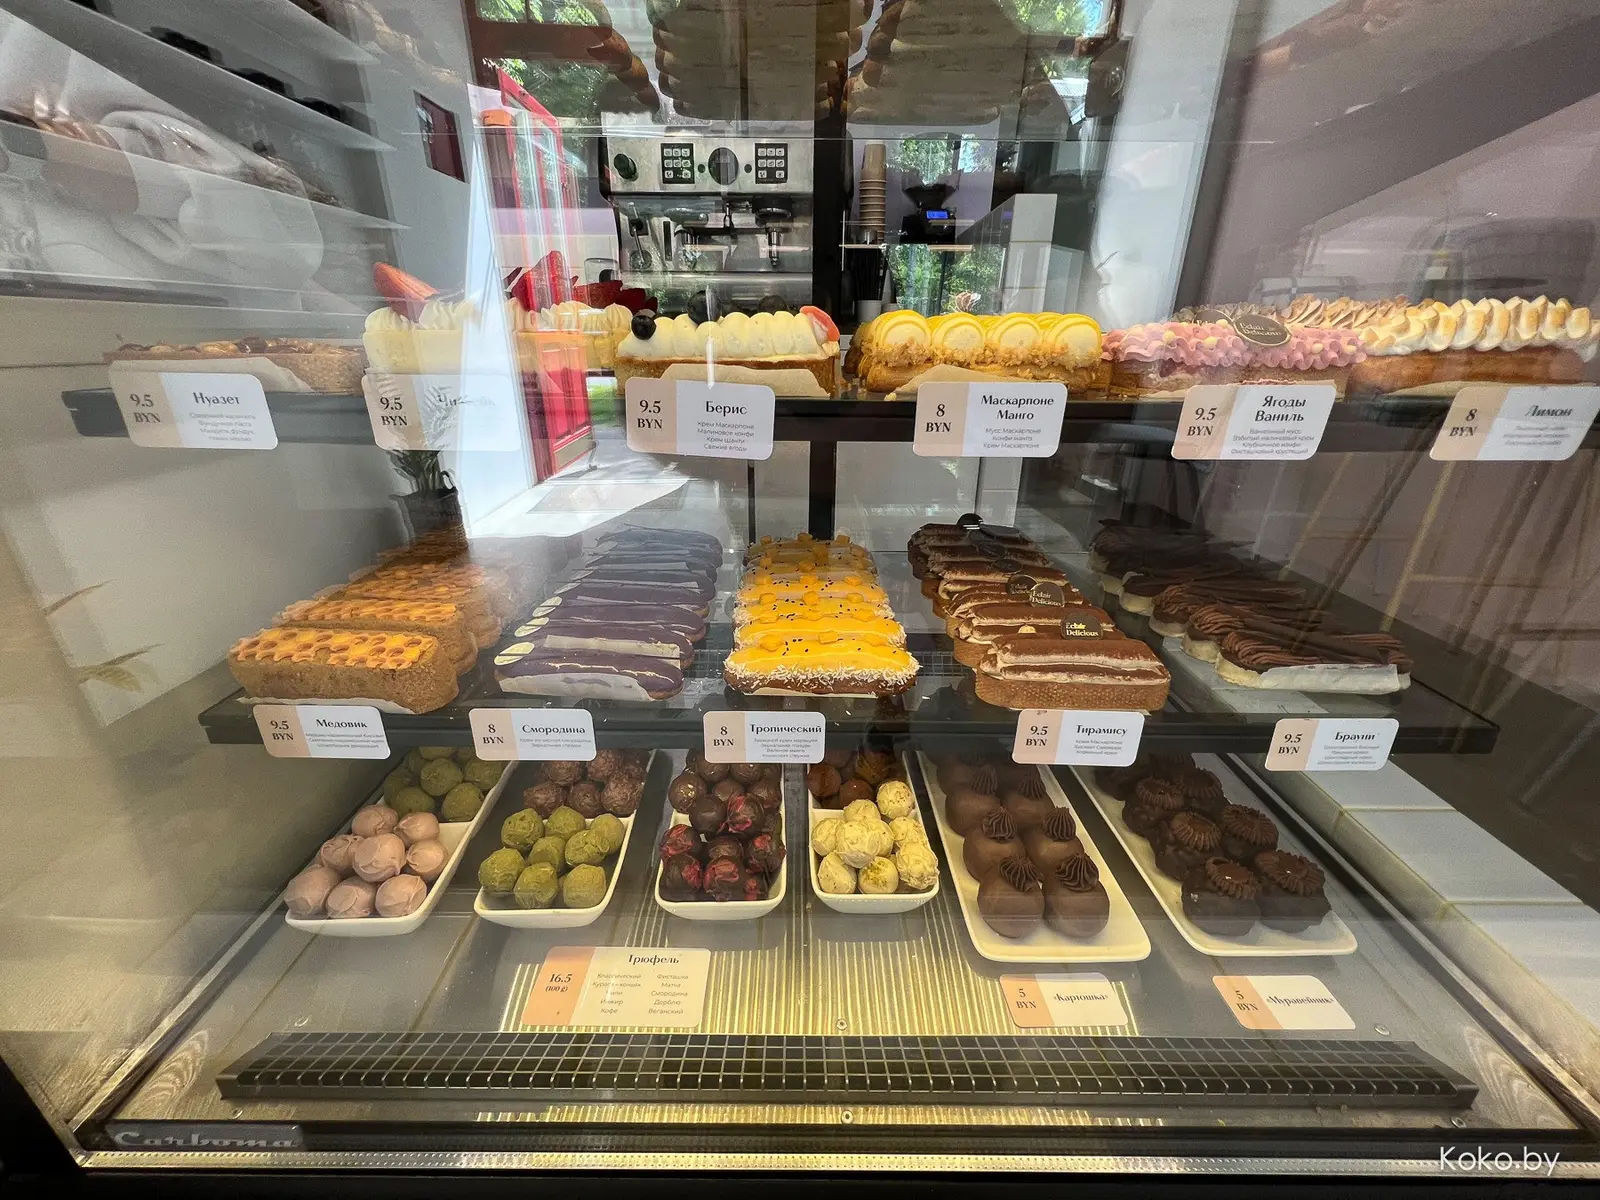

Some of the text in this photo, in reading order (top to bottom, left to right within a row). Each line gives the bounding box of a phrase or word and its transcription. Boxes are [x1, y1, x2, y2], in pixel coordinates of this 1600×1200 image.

[129, 393, 155, 408] 9.5
[193, 392, 240, 408] Нуазет
[379, 396, 403, 411] 9.5
[980, 395, 1054, 408] Маскарпоне
[1262, 395, 1307, 408] Ягоды
[639, 400, 662, 414] 9.5
[705, 401, 748, 417] Берис
[936, 403, 945, 417] 8
[1524, 404, 1573, 417] Лимон
[133, 412, 161, 424] BYN
[996, 410, 1034, 421] Манго
[1195, 407, 1217, 421] 9.5
[1255, 410, 1304, 422] Ваниль
[1465, 408, 1478, 422] 8
[381, 415, 408, 426] BYN
[637, 418, 663, 429] BYN
[925, 422, 952, 433] BYN
[1187, 425, 1213, 436] BYN
[1449, 426, 1478, 437] BYN
[270, 720, 289, 730] 9.5
[316, 719, 368, 729] Медовик
[488, 724, 496, 733] 8
[750, 724, 822, 735] Тропический
[521, 724, 586, 736] Смородина
[720, 726, 728, 736] 8
[1030, 725, 1048, 736] 9.5
[1076, 725, 1128, 737] Тирамису
[272, 732, 294, 741] BYN
[482, 736, 504, 744] BYN
[1284, 733, 1303, 743] 9.5
[1335, 731, 1375, 743] Брауни
[1025, 739, 1047, 747] BYN
[1278, 746, 1300, 755] BYN
[628, 954, 680, 965] Трюфель
[549, 973, 572, 983] 16.5
[1018, 988, 1026, 998] 5
[1235, 990, 1244, 1000] 5
[1016, 1001, 1037, 1009] BYN
[1236, 1003, 1259, 1011] BYN
[114, 1131, 300, 1148] Carboma
